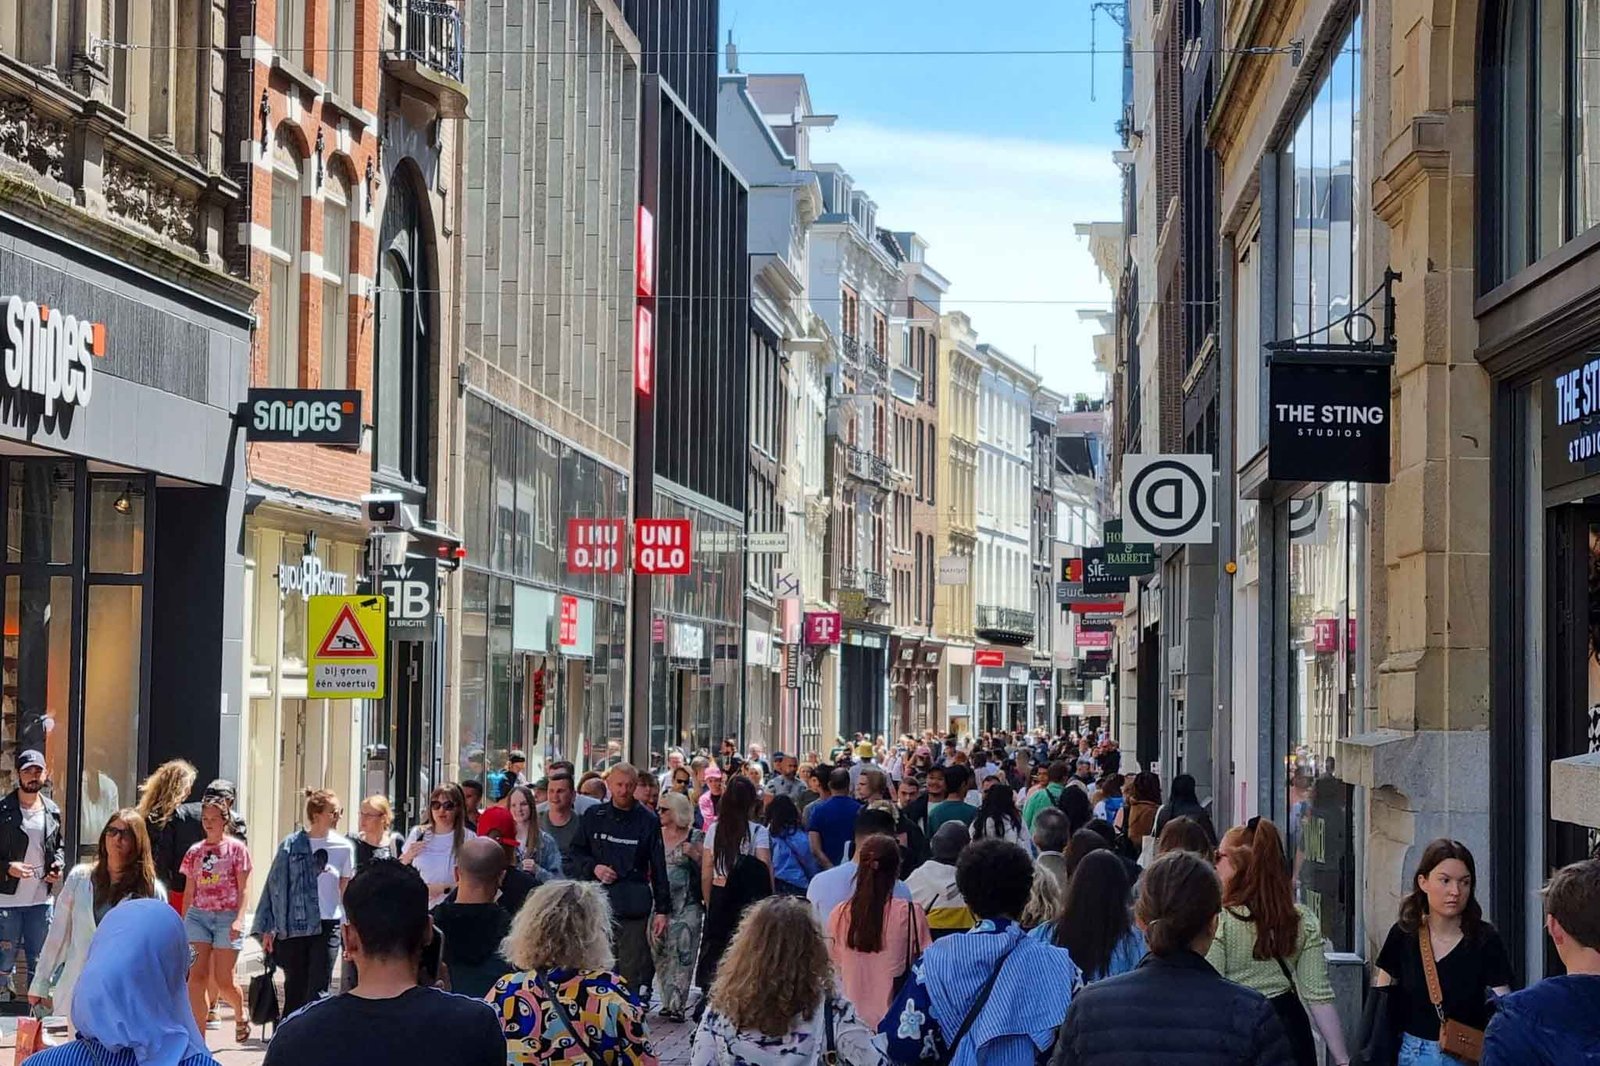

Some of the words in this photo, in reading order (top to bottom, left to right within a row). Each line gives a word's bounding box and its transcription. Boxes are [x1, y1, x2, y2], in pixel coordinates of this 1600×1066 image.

[5, 295, 93, 417] snipes
[1556, 369, 1580, 425] THE
[253, 400, 342, 437] snipes
[1275, 404, 1315, 422] THE
[1321, 405, 1384, 424] STING
[1298, 428, 1361, 437] STUDIOS
[641, 526, 681, 546] UNI
[641, 548, 685, 571] QLO
[1107, 553, 1151, 564] BARRETT
[397, 620, 427, 628] BRIGITTE
[325, 667, 337, 677] bij
[340, 668, 367, 677] groen
[336, 681, 376, 689] voertuig
